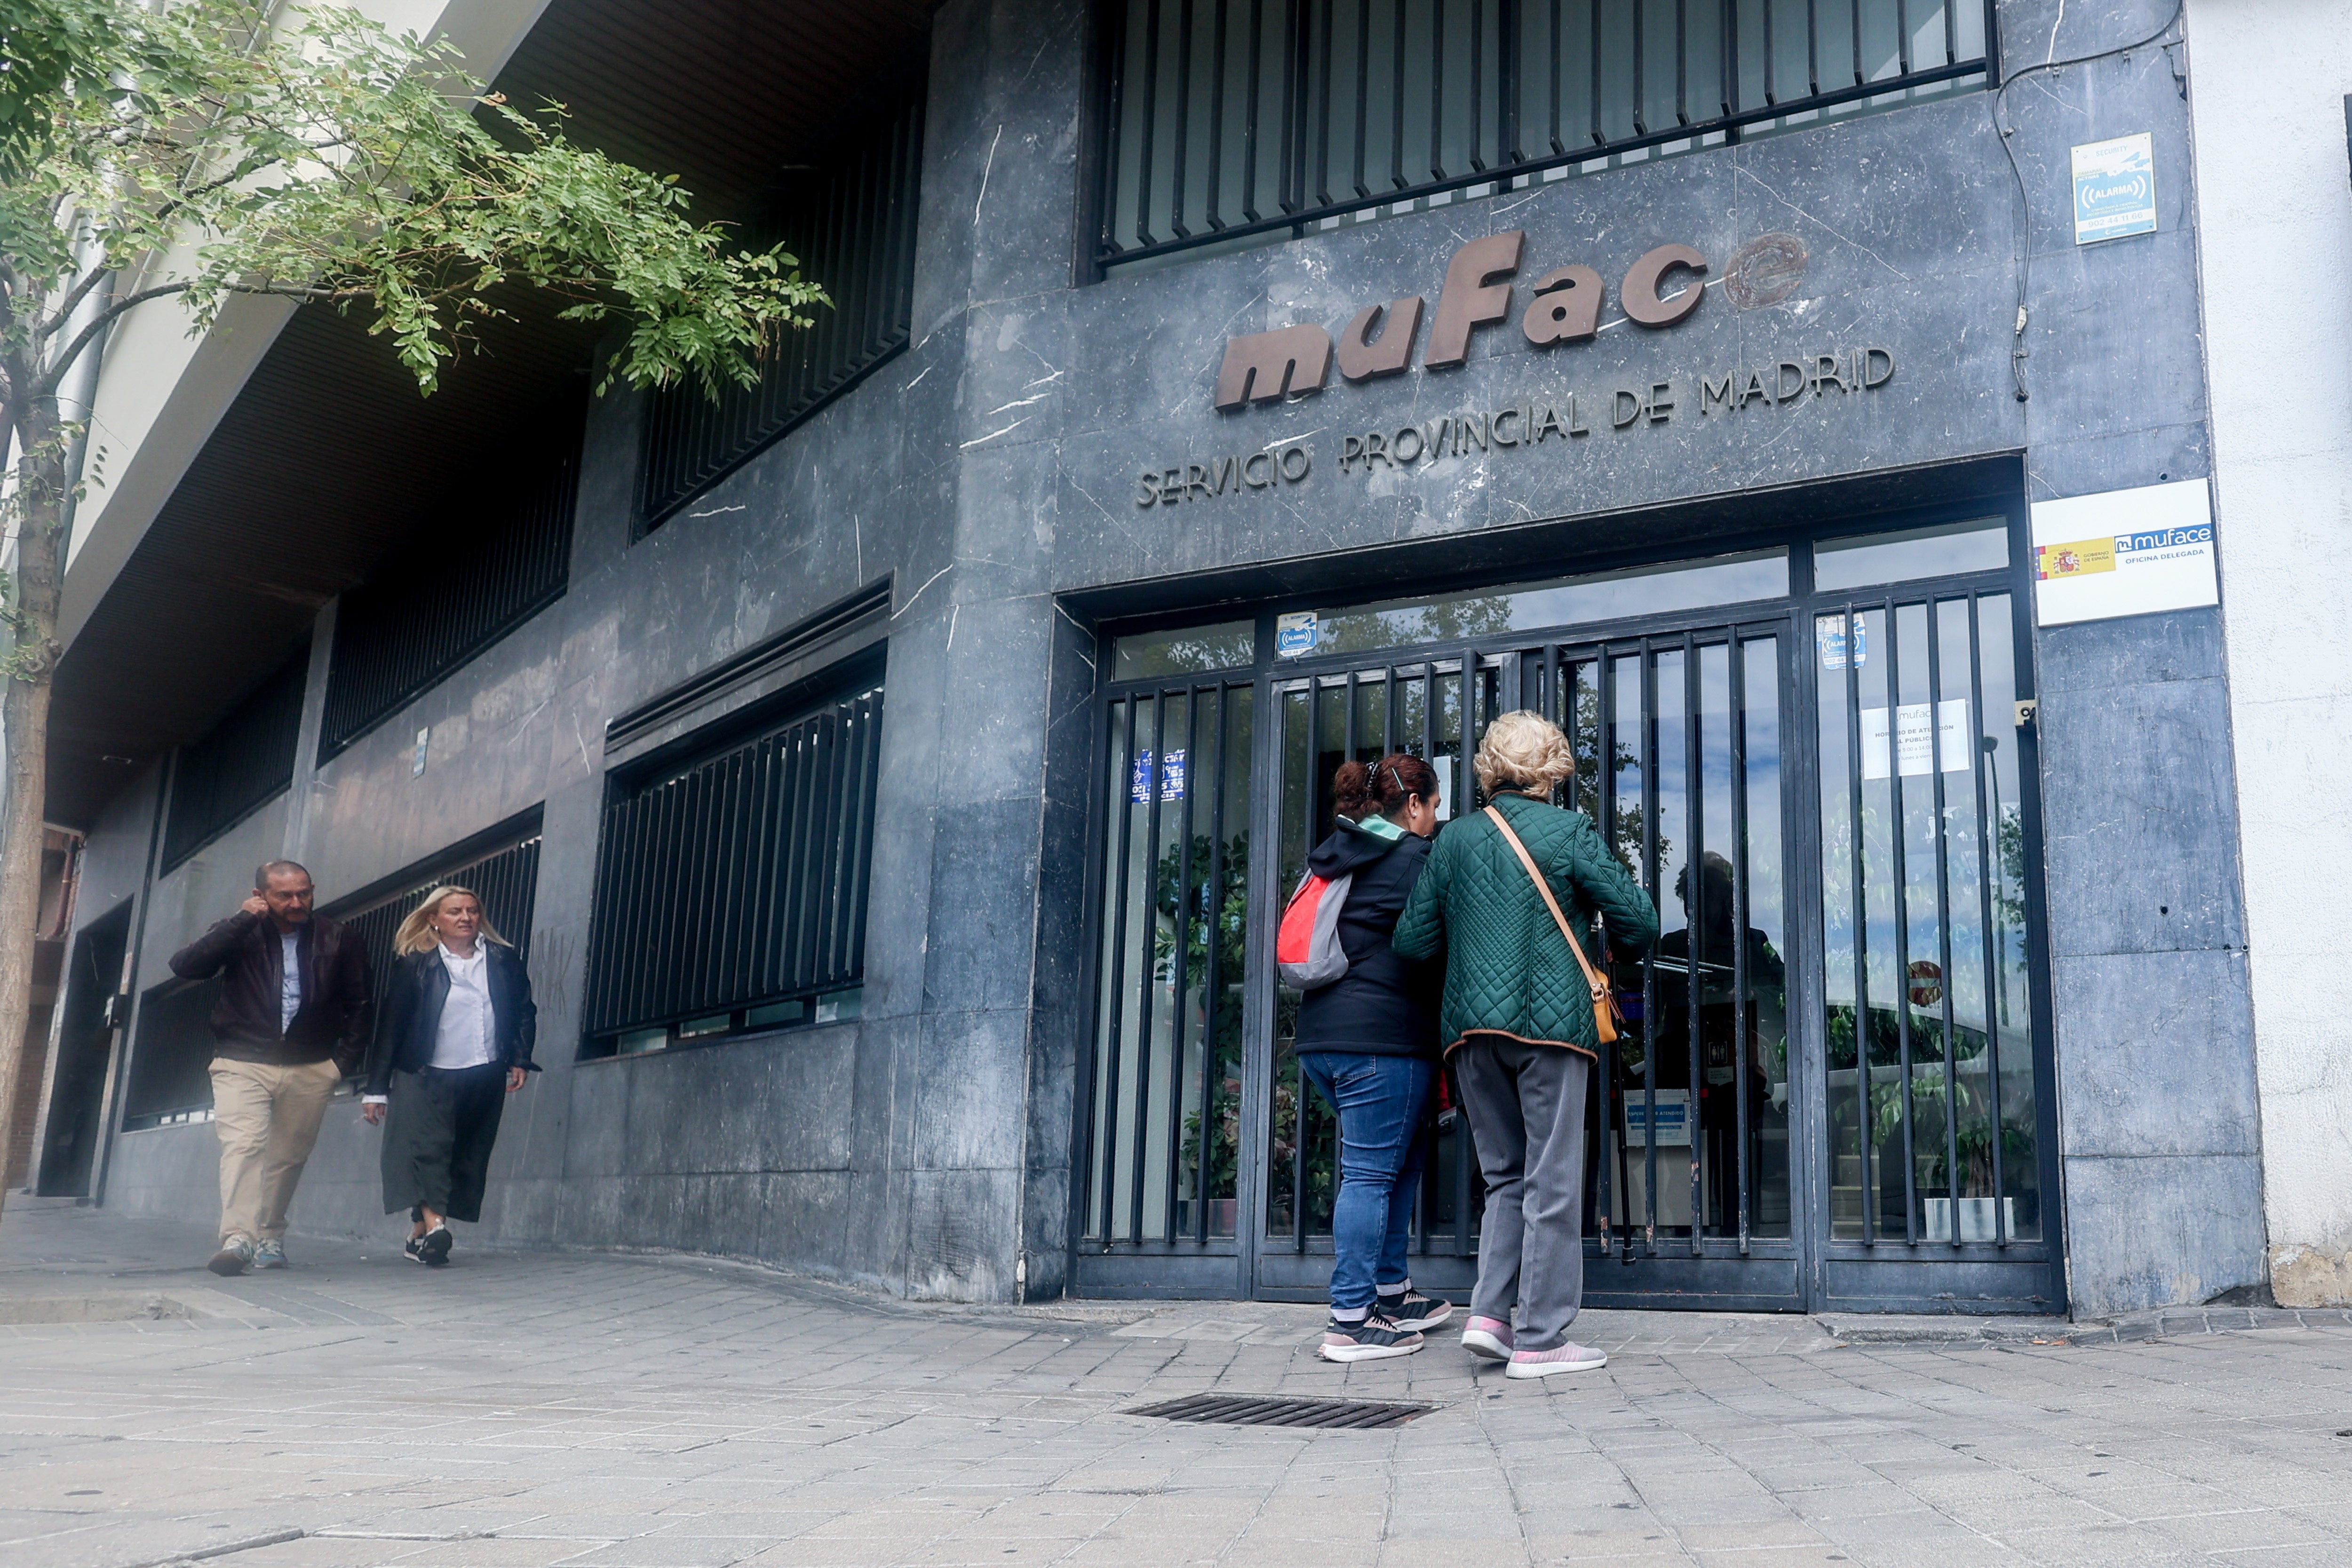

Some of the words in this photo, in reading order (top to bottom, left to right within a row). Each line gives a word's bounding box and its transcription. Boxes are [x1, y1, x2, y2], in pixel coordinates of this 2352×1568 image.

[2095, 184, 2133, 199] ALARMA
[2089, 219, 2105, 228] 902
[1137, 448, 1311, 507] SERVICIO
[1339, 397, 1589, 473] PROVINCIAL
[1614, 382, 1675, 429] DE
[1701, 348, 1896, 414] MADRID
[2135, 528, 2211, 550] muface
[2125, 555, 2158, 564] OFICINA
[2161, 549, 2204, 559] DELEGADA
[1899, 709, 1931, 720] mufac
